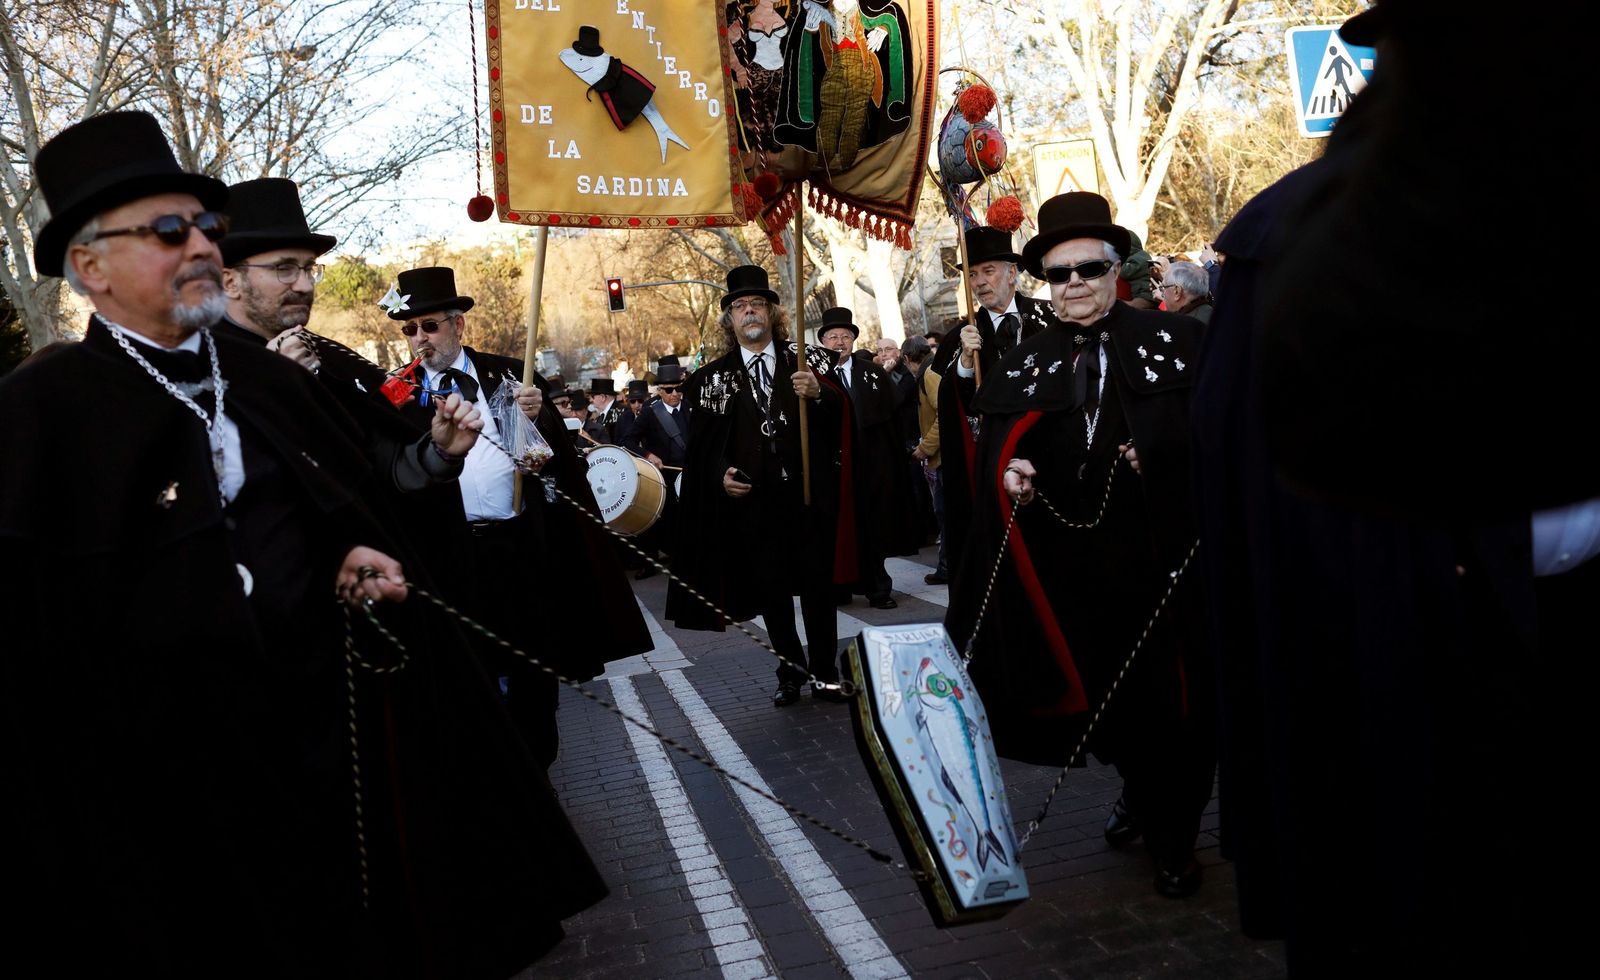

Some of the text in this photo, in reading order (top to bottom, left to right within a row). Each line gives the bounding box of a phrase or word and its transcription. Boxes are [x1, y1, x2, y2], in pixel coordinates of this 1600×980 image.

[514, 0, 561, 12] DEL
[616, 0, 720, 118] ENTIERRO
[520, 104, 553, 124] DE
[548, 139, 581, 159] LA
[577, 175, 689, 197] SARDINA
